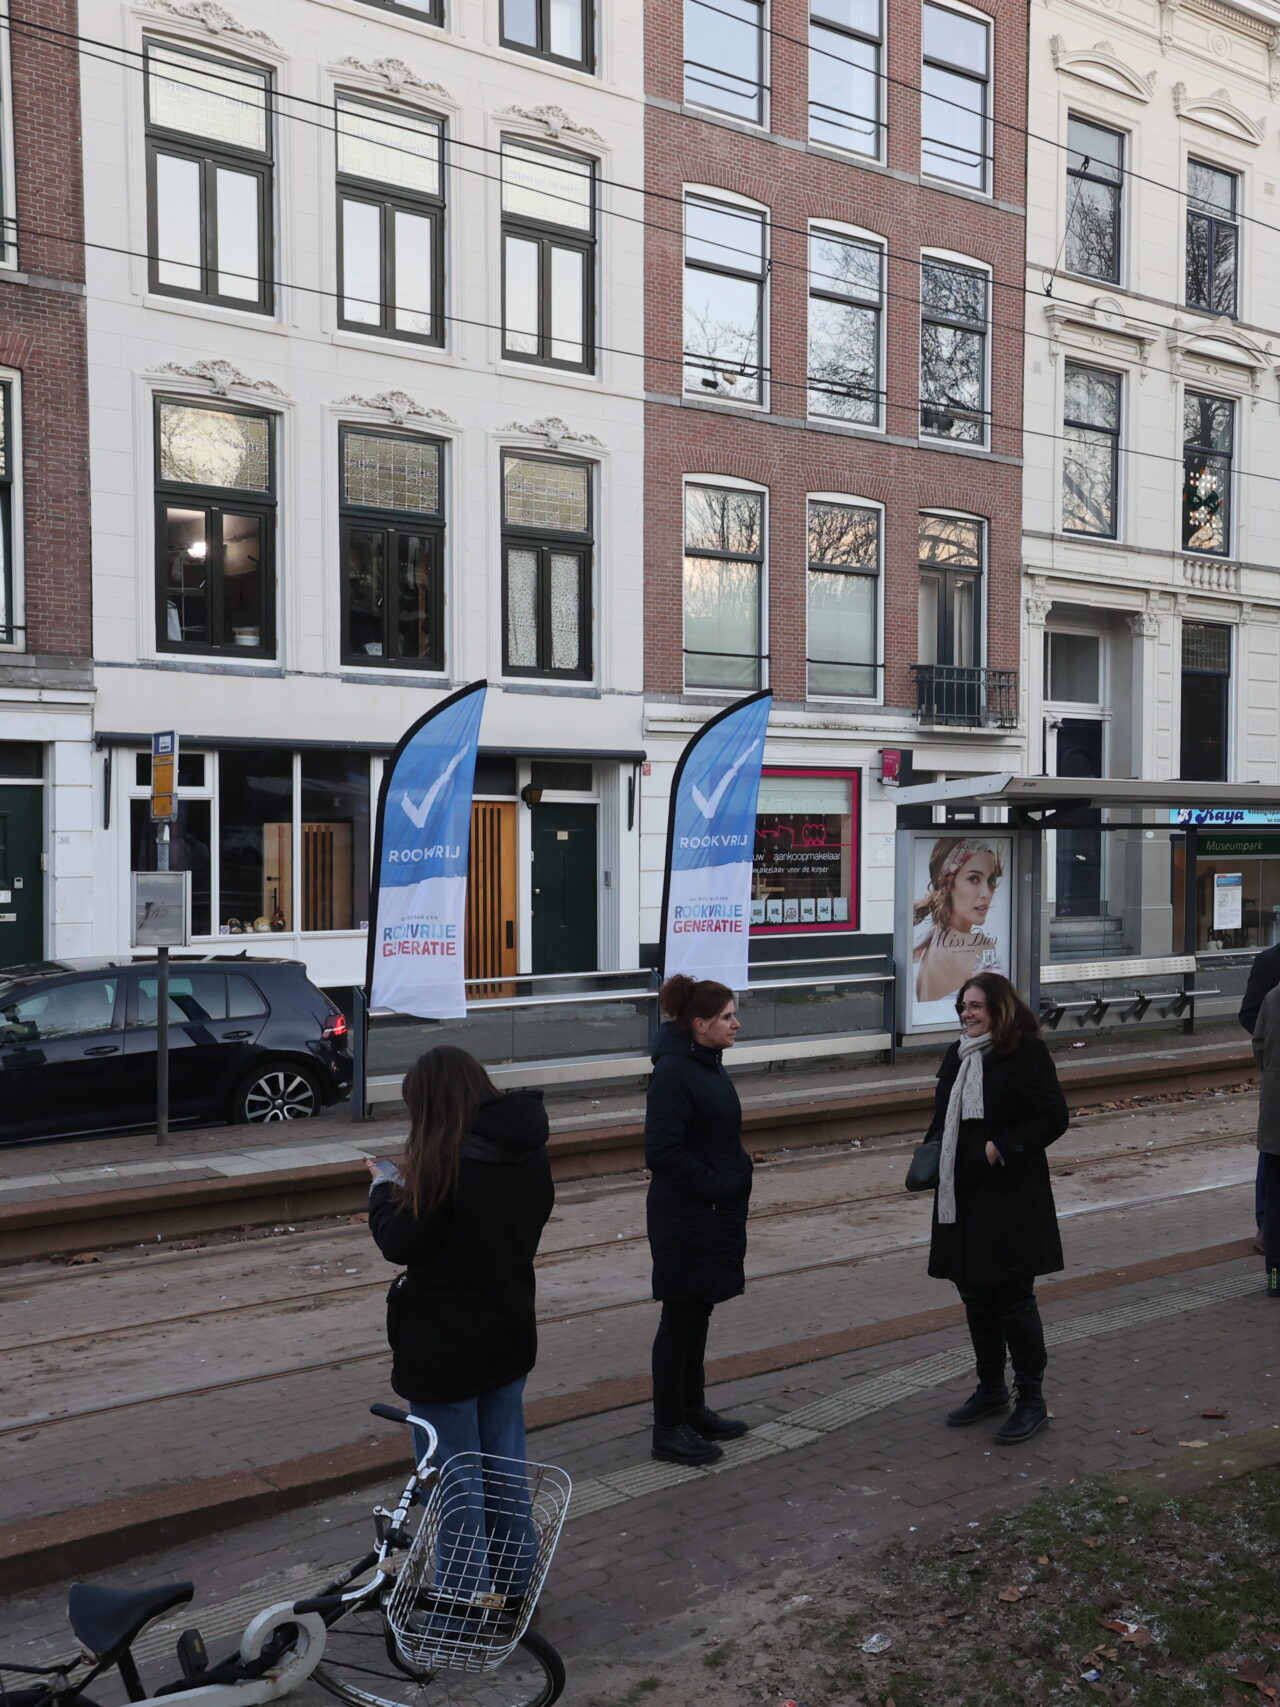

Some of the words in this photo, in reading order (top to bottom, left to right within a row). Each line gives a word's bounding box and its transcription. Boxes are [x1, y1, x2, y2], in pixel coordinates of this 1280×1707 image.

[680, 834, 748, 849] ROOKVRIJ
[1206, 840, 1263, 852] Museumpark
[773, 851, 841, 863] aankoopmakelaar
[674, 903, 743, 919] ROOKVRIJE
[673, 919, 743, 934] GENERATIE
[933, 927, 966, 949] Miss
[967, 927, 998, 947] Dior
